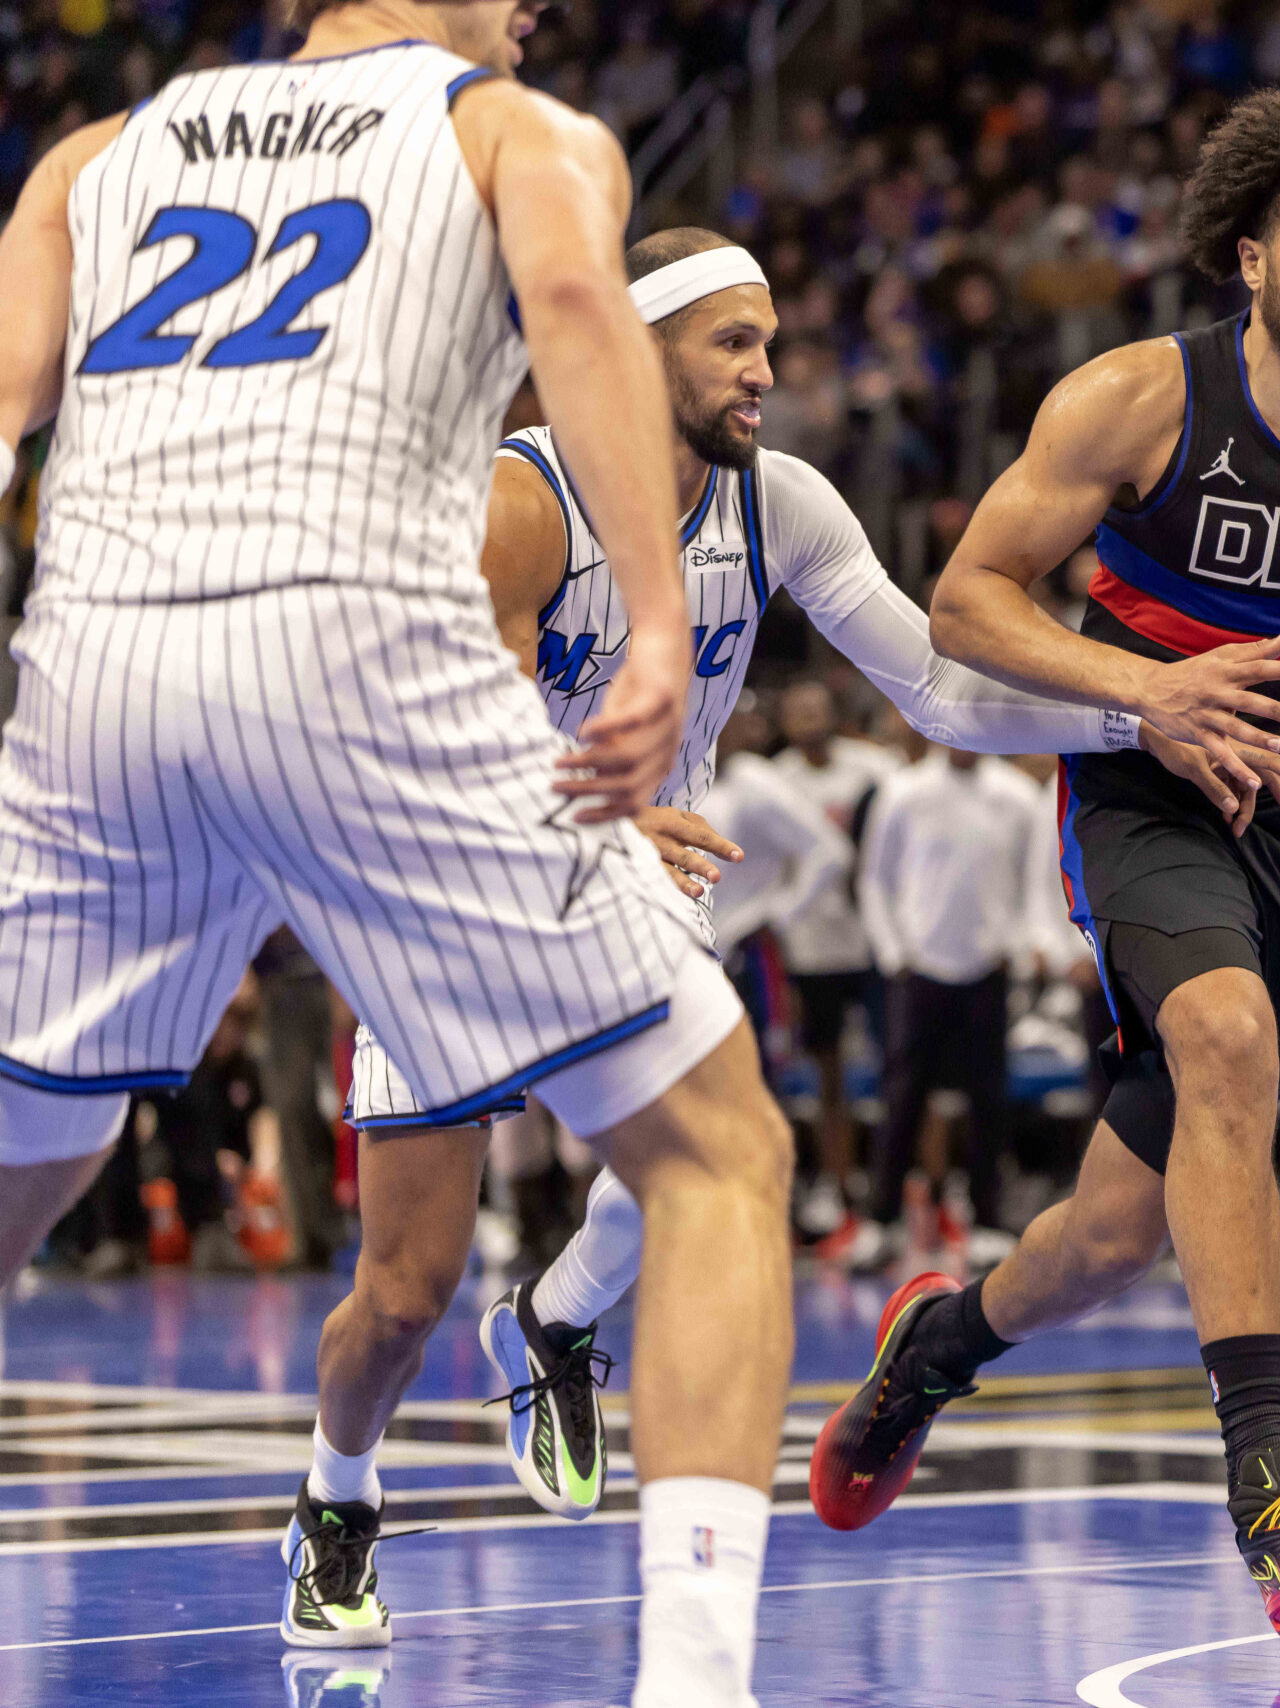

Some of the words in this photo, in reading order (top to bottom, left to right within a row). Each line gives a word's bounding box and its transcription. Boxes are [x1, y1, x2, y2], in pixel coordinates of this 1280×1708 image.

[169, 101, 386, 166] WAGNER
[76, 197, 372, 375] 22
[690, 546, 744, 570] Disney
